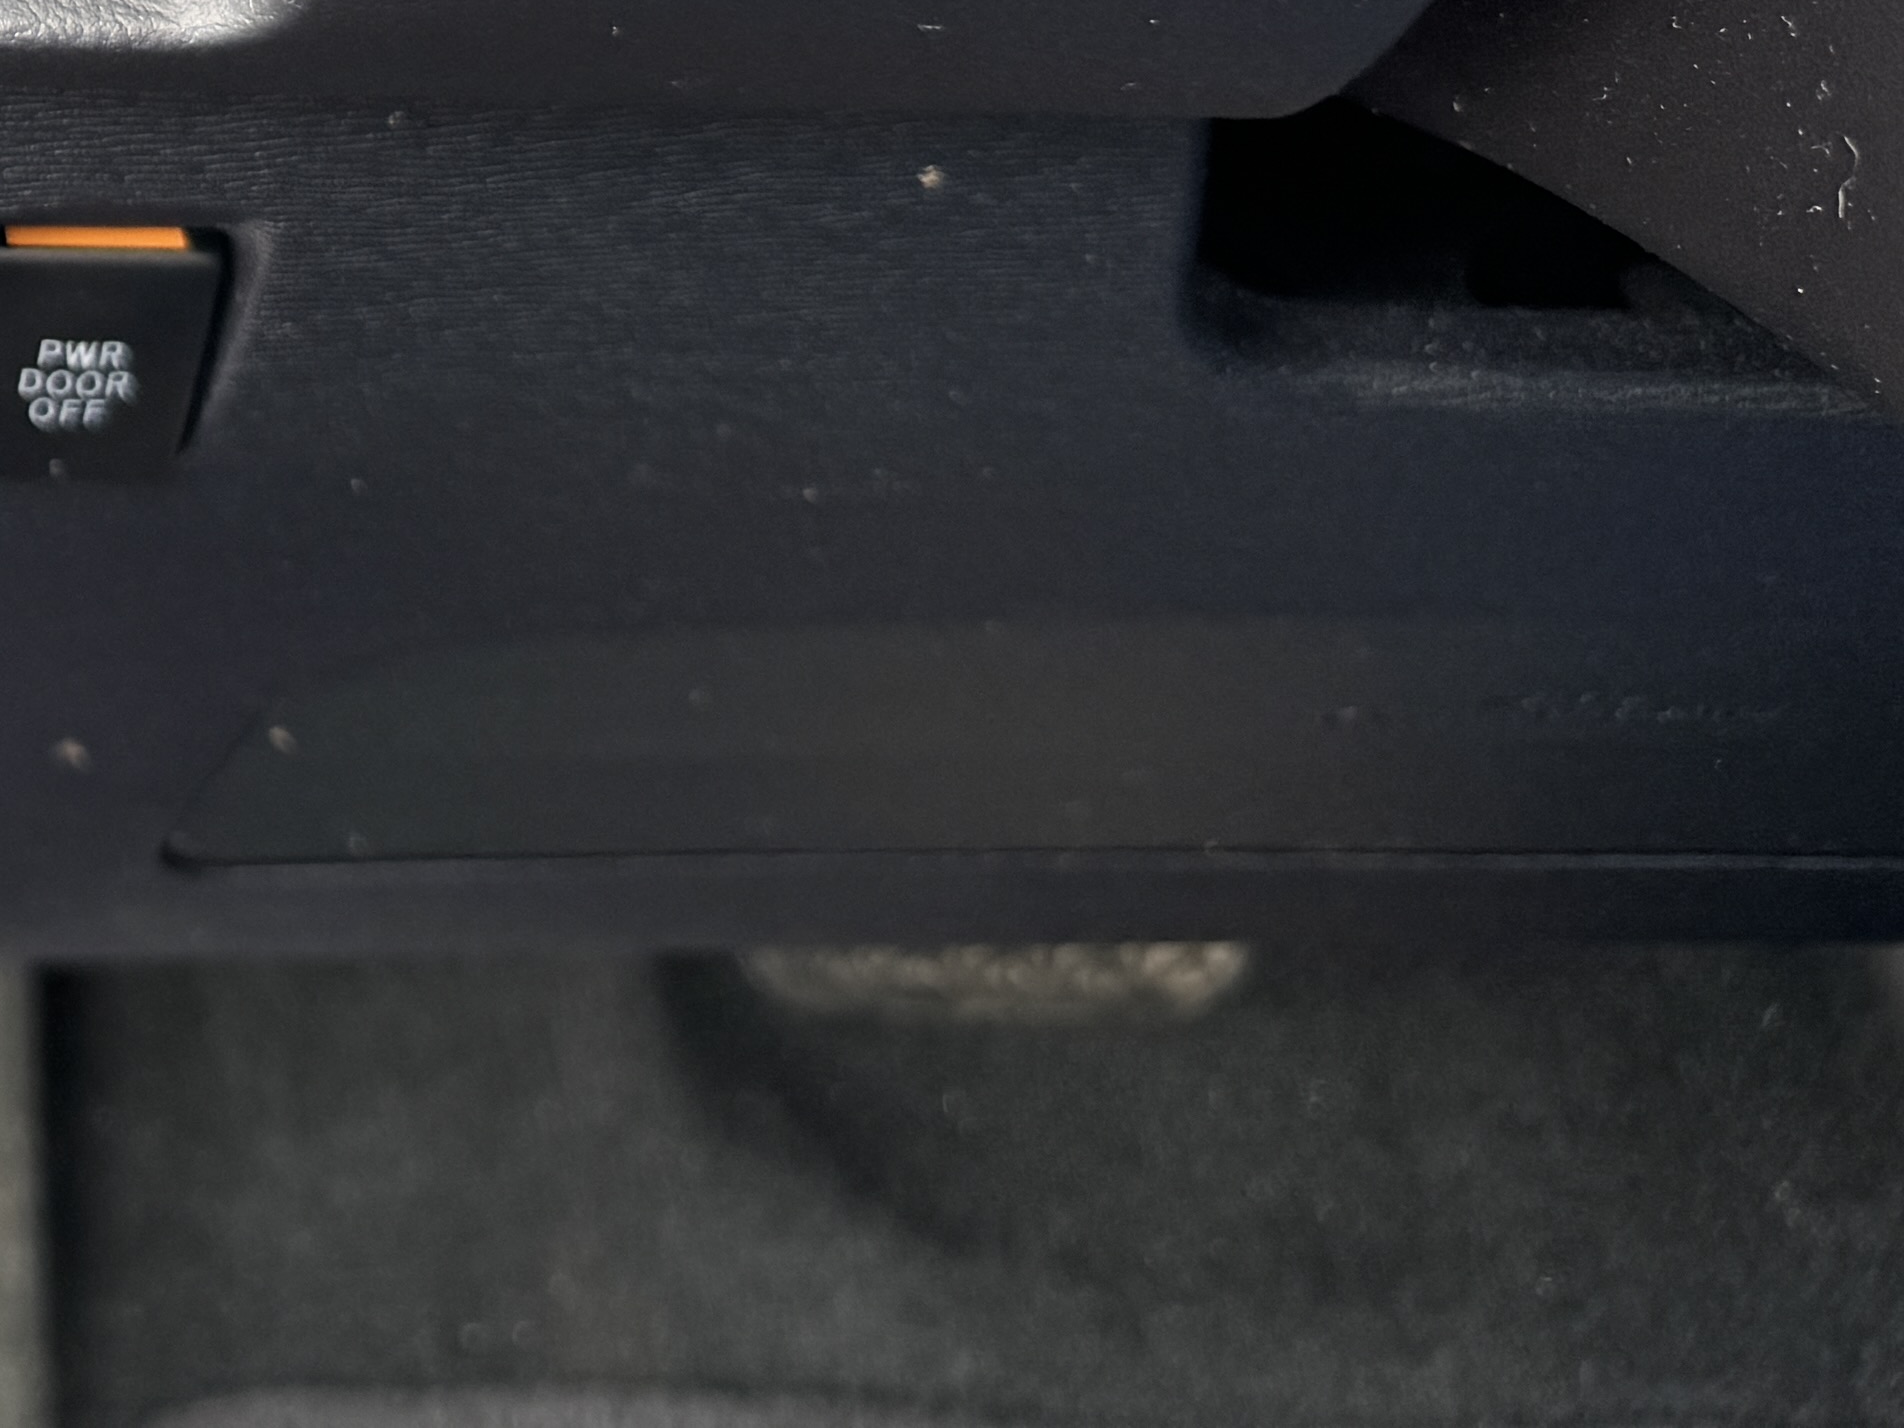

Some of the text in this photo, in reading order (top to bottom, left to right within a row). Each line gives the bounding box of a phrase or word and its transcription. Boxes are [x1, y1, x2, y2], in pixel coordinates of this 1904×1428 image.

[37, 339, 133, 369] PWR
[18, 367, 138, 404] DOOR
[28, 396, 109, 431] OFF
